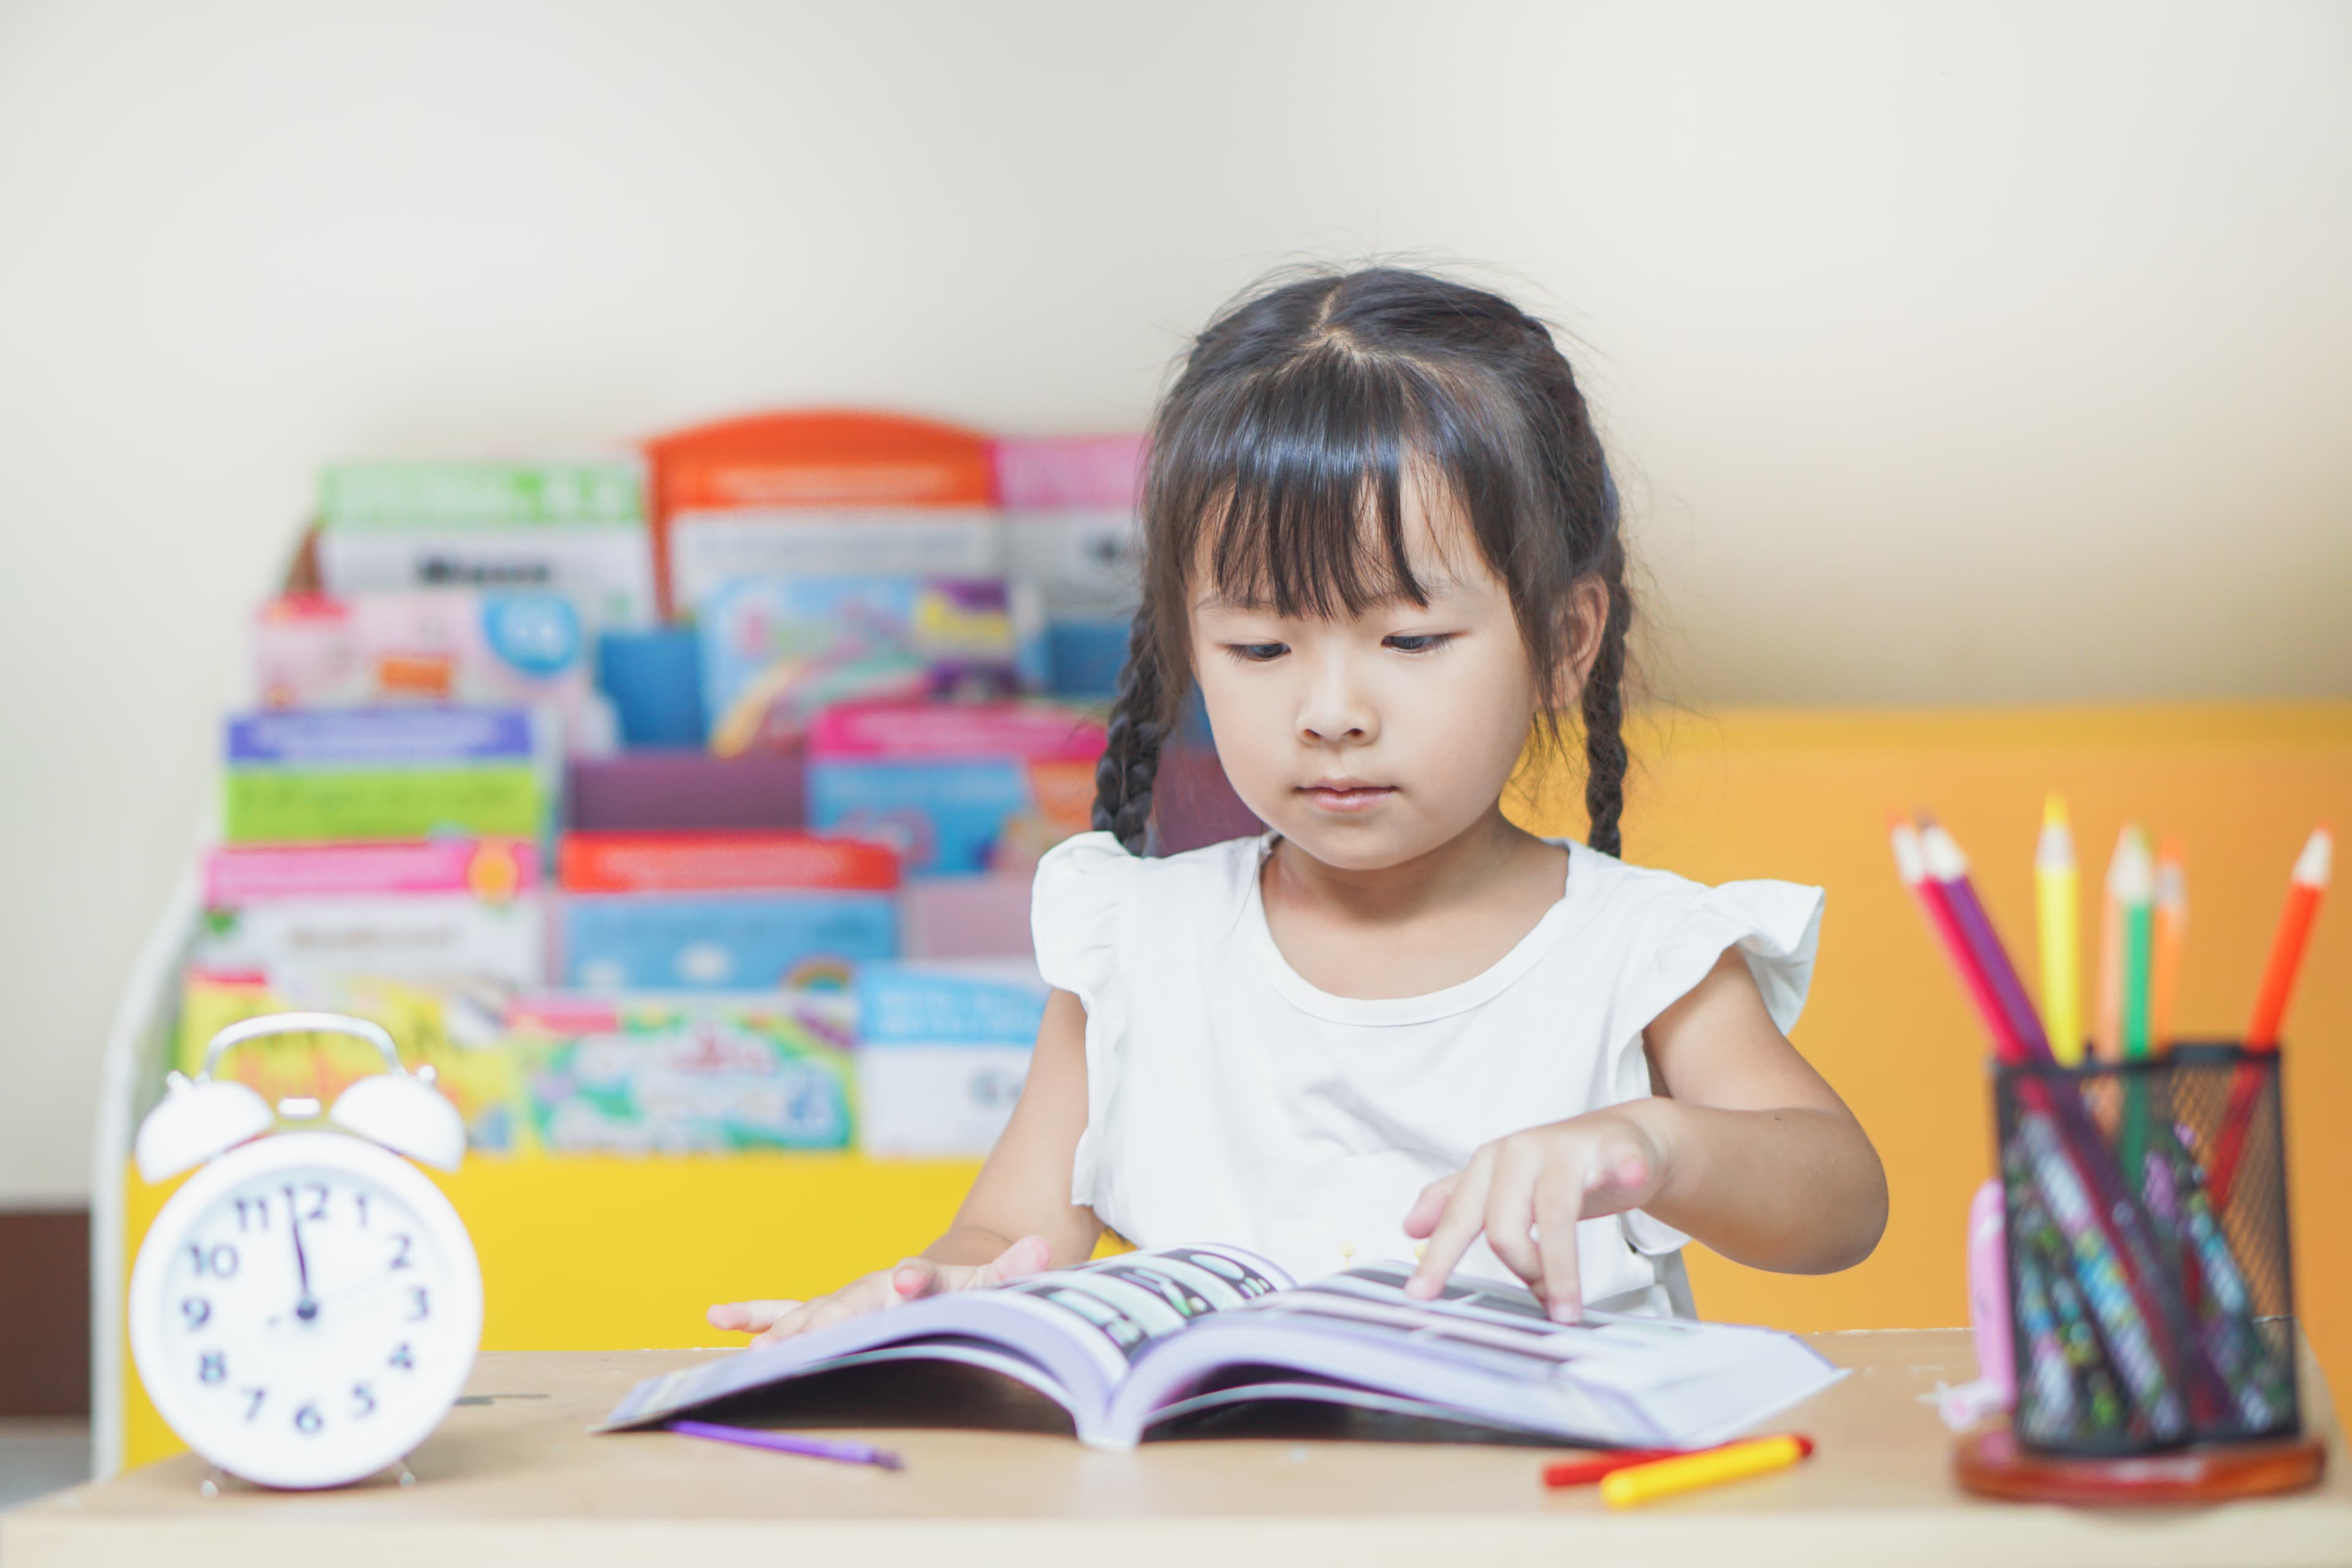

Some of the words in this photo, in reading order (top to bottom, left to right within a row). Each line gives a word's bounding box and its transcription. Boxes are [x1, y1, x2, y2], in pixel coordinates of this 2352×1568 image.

[234, 1196, 269, 1232] 11
[283, 1182, 329, 1222] 12
[355, 1191, 368, 1227] 1
[189, 1242, 239, 1280] 10
[388, 1232, 412, 1270] 2
[181, 1296, 211, 1332] 9
[409, 1286, 429, 1321] 3
[198, 1351, 227, 1385] 8
[388, 1341, 413, 1371] 4
[243, 1386, 265, 1420] 7
[351, 1383, 375, 1417] 5
[294, 1402, 323, 1434] 6
